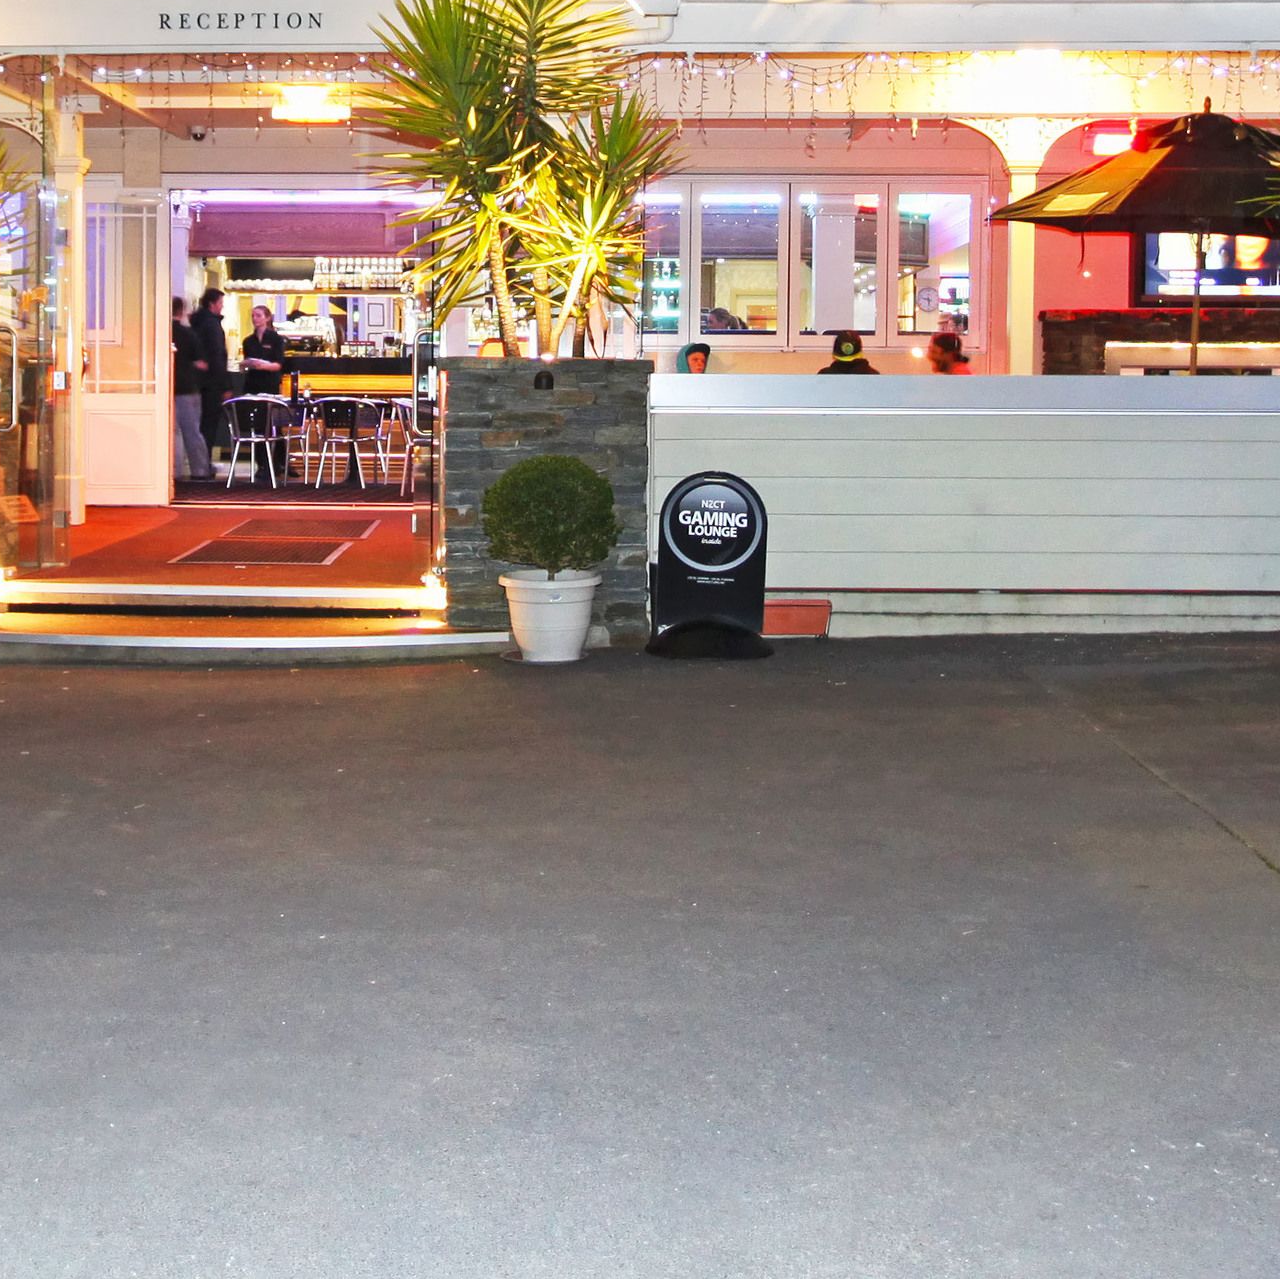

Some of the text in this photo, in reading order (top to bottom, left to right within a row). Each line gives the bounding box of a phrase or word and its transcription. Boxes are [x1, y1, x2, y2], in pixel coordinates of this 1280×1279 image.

[159, 12, 324, 30] RECEPTION
[678, 510, 748, 527] GAMING
[688, 525, 738, 537] LOUNGE
